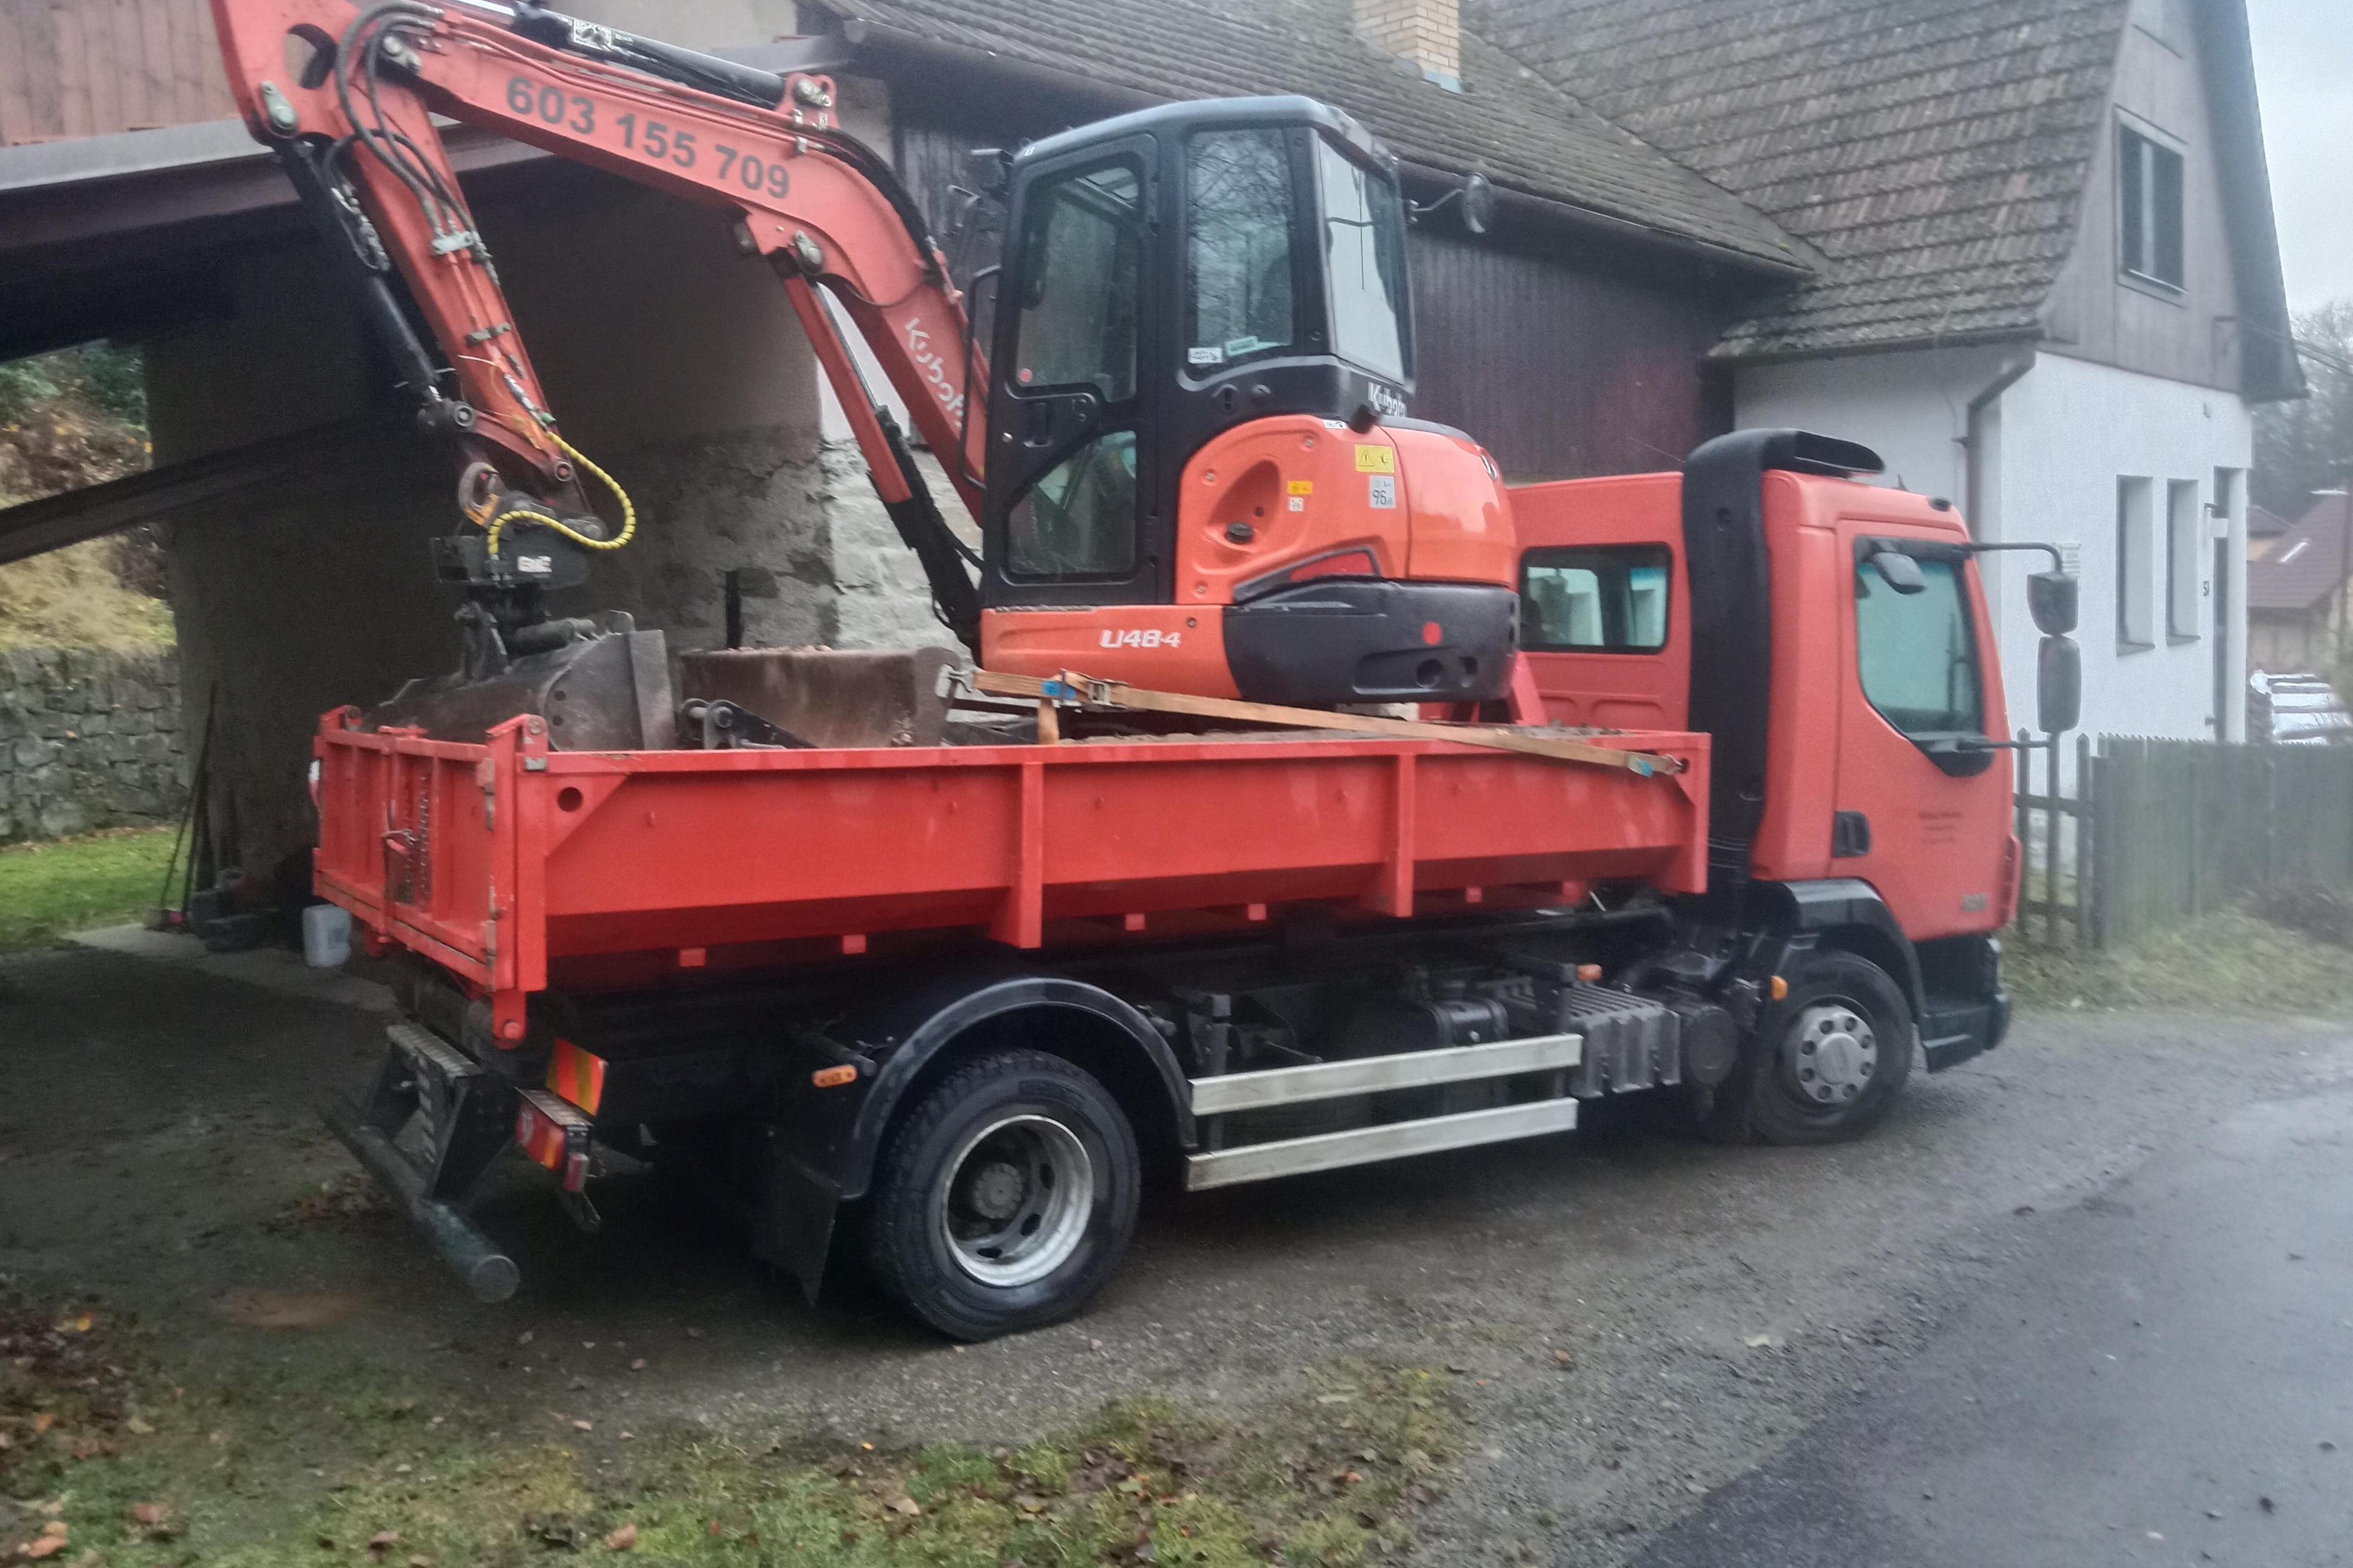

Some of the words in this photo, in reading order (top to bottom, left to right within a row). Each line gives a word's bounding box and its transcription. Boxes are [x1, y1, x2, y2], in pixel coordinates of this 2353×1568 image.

[506, 76, 595, 135] 603
[616, 113, 696, 168] 155
[715, 145, 789, 199] 709
[1373, 489, 1387, 505] 96
[1099, 629, 1182, 648] U48-4
